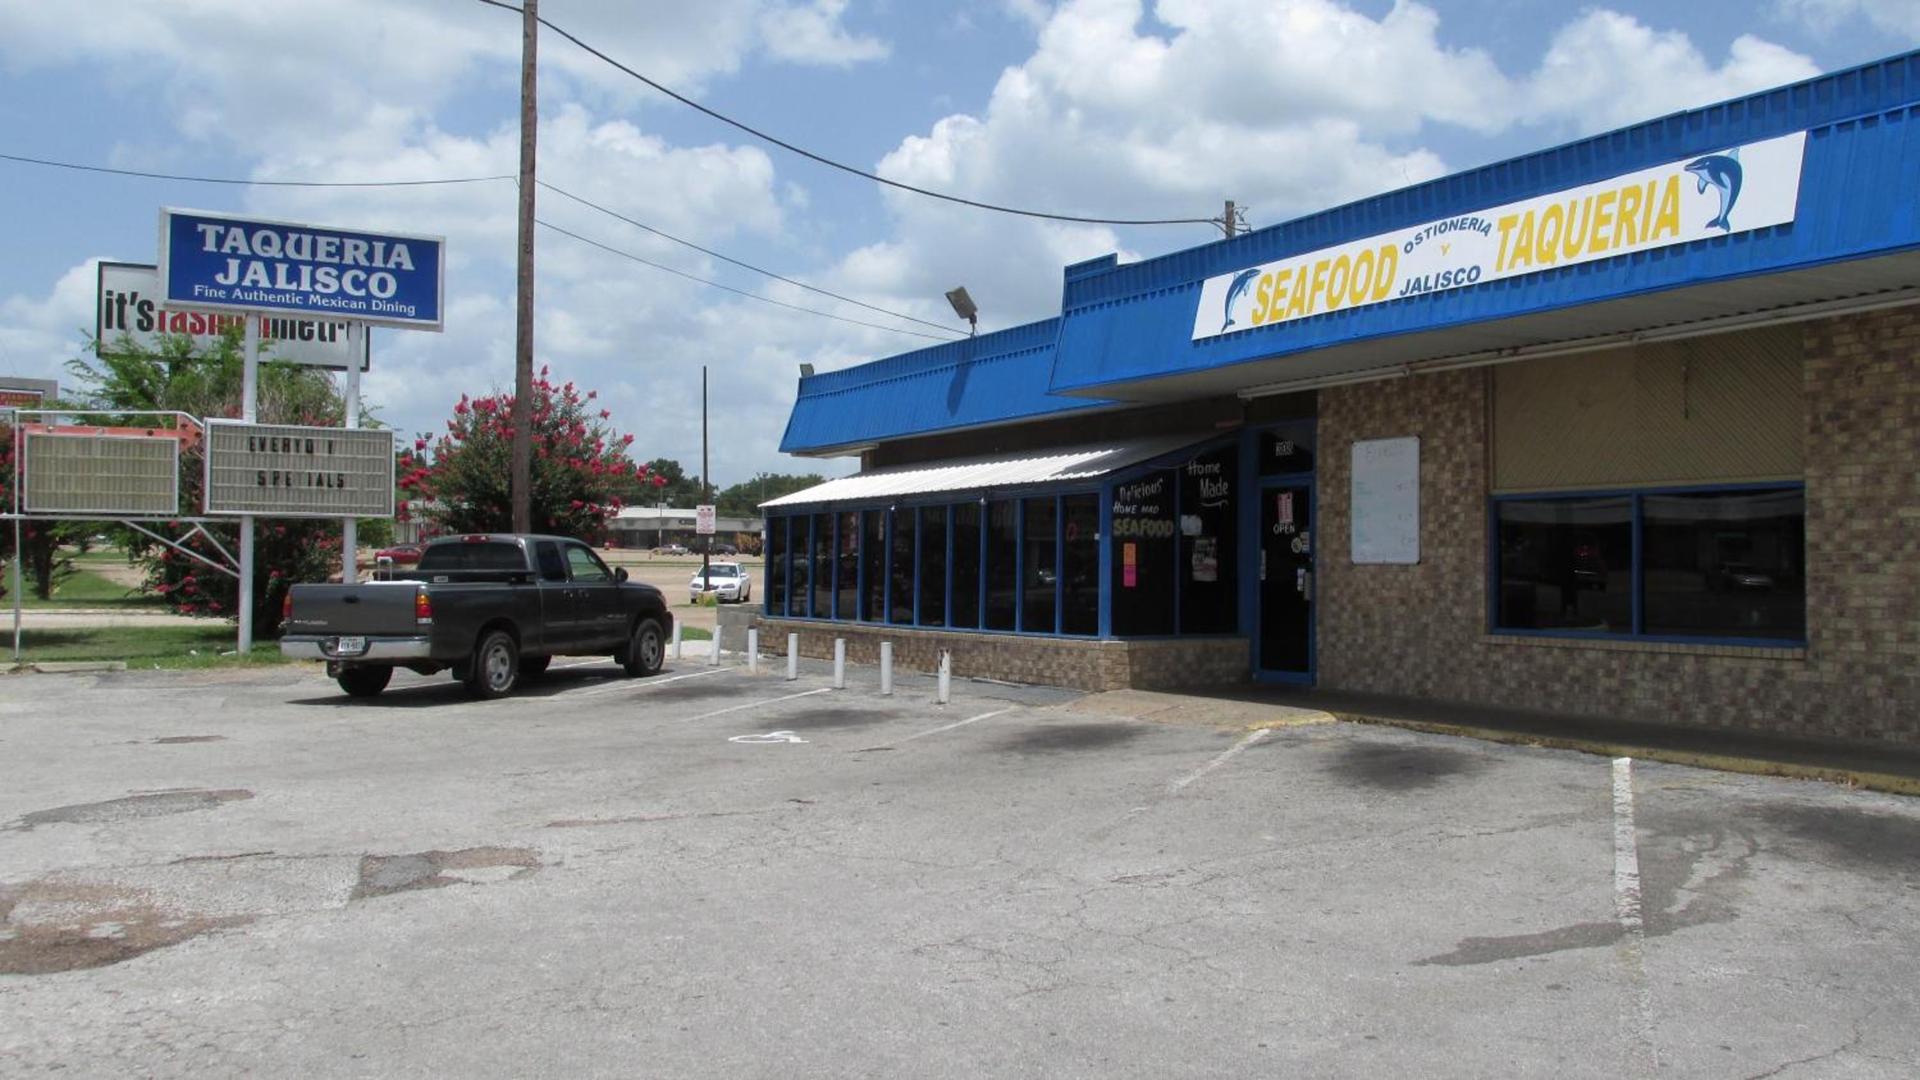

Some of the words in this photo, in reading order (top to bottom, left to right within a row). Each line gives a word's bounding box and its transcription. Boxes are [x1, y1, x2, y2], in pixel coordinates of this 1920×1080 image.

[1404, 217, 1492, 254] OSTIONERIA
[1495, 174, 1680, 273] TAQUERIA
[197, 223, 415, 271] TAQUERIA
[215, 258, 397, 298] JALISCO
[1251, 244, 1398, 325] SEAFOOD
[1400, 265, 1482, 296] JALISCO
[194, 284, 226, 298] Fine
[232, 288, 303, 305] Authentic
[309, 294, 366, 311] Mexican
[372, 300, 416, 316] Dining
[1113, 518, 1173, 538] SEAFOOD
[1273, 523, 1295, 534] OPEN
